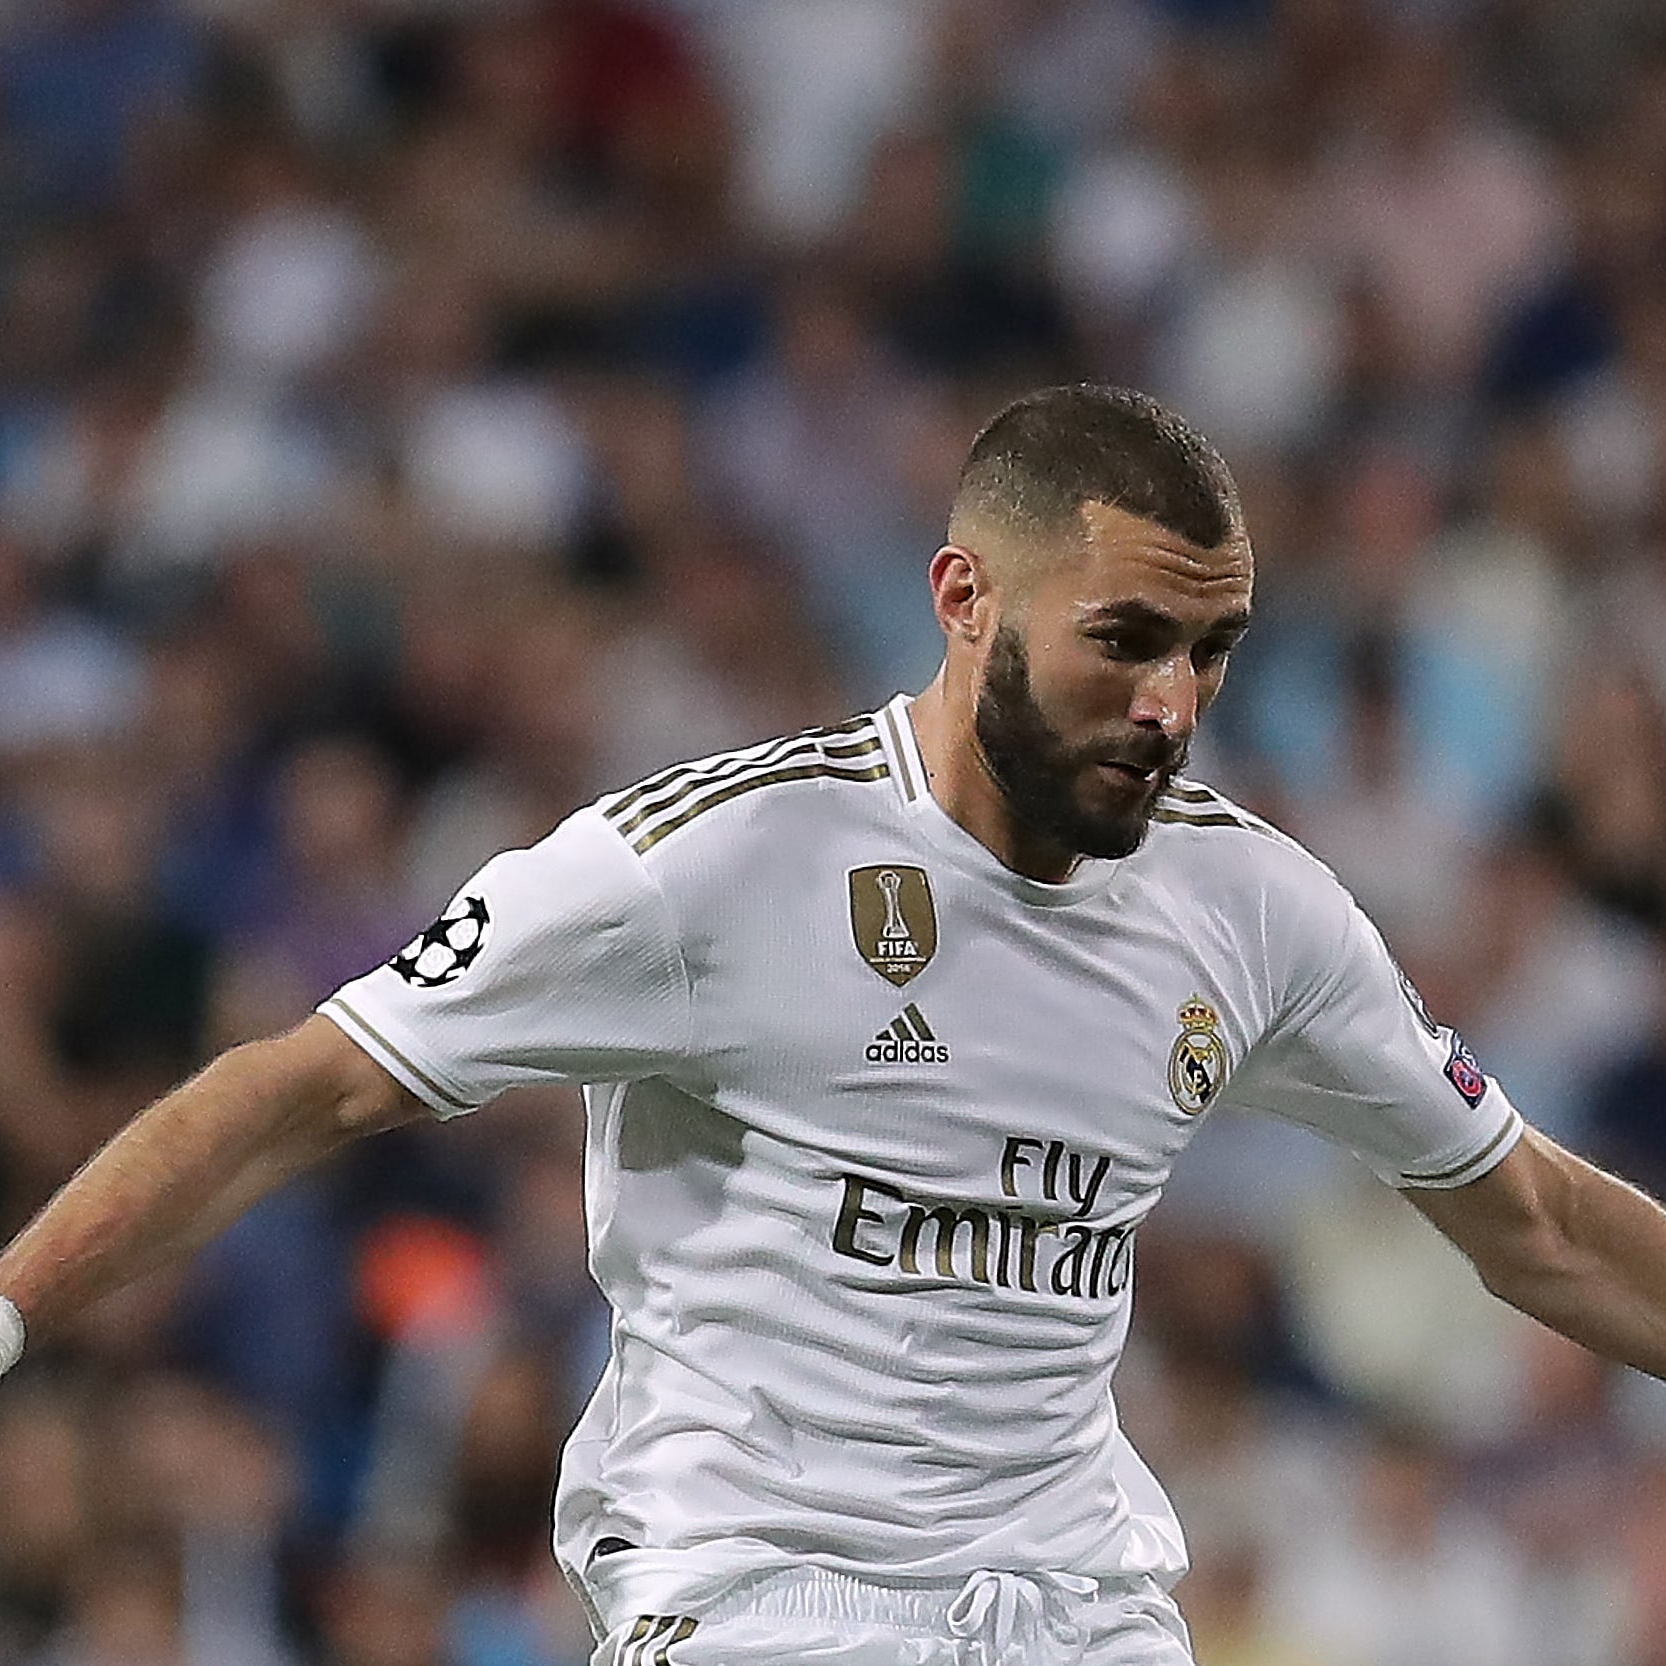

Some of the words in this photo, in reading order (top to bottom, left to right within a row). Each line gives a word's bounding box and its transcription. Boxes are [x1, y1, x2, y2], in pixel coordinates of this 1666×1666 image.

[877, 940, 917, 956] FIFA
[865, 1040, 949, 1063] adidas
[1001, 1136, 1111, 1217] Fly
